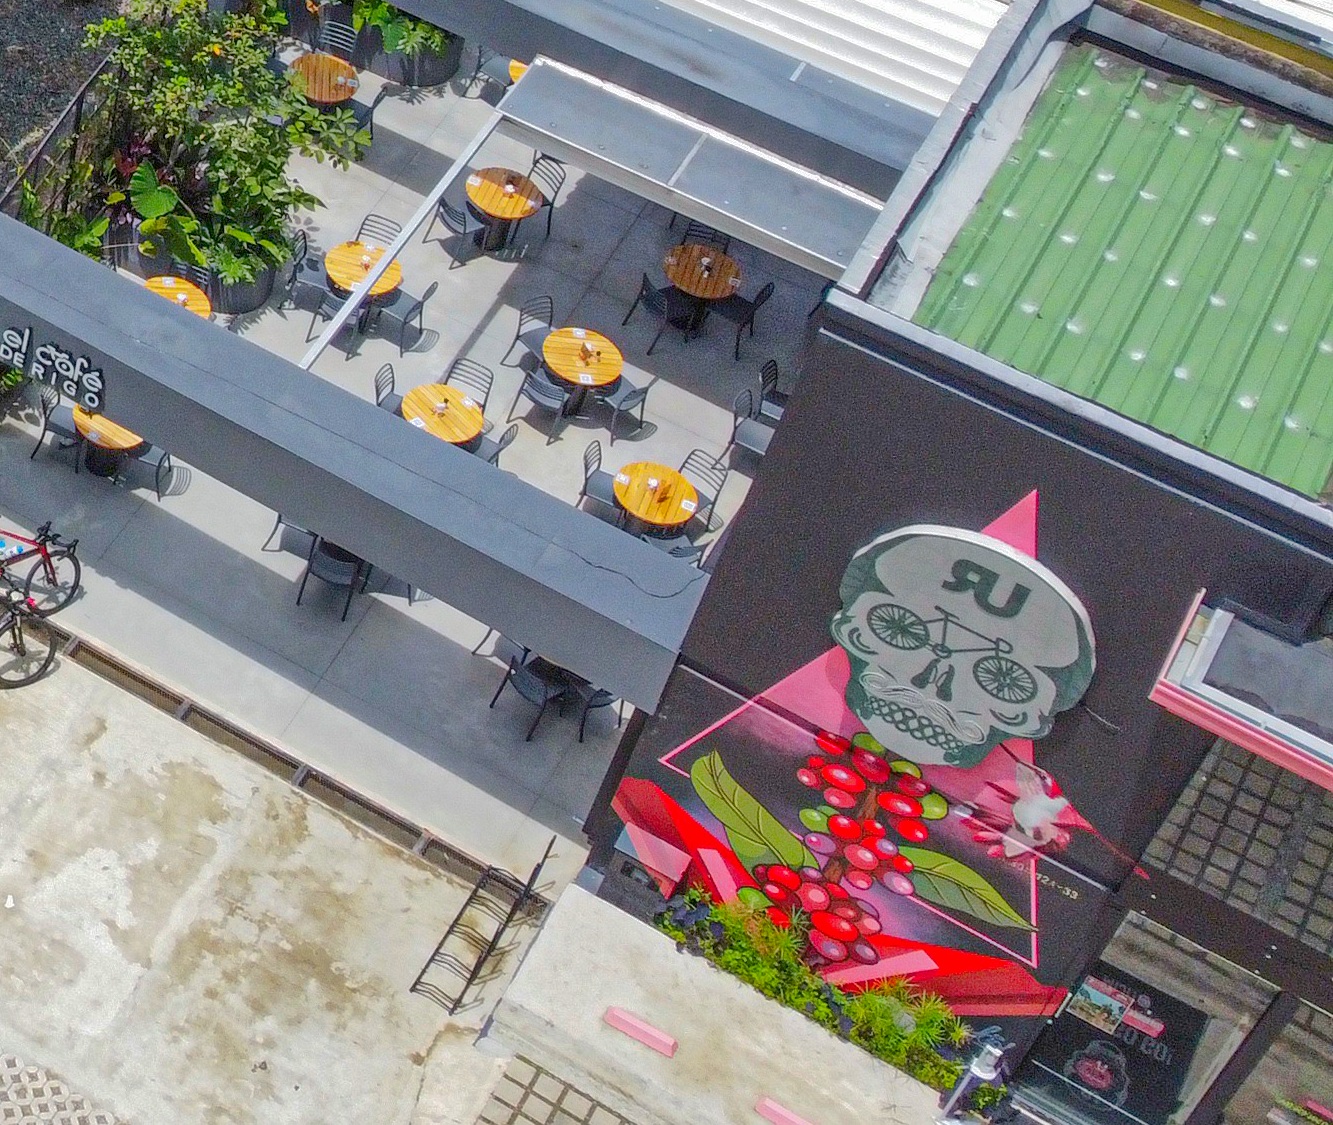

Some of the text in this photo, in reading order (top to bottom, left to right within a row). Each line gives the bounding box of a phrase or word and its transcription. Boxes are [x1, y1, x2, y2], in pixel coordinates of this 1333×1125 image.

[0, 343, 99, 408] DE RIGO
[3, 328, 103, 393] el café
